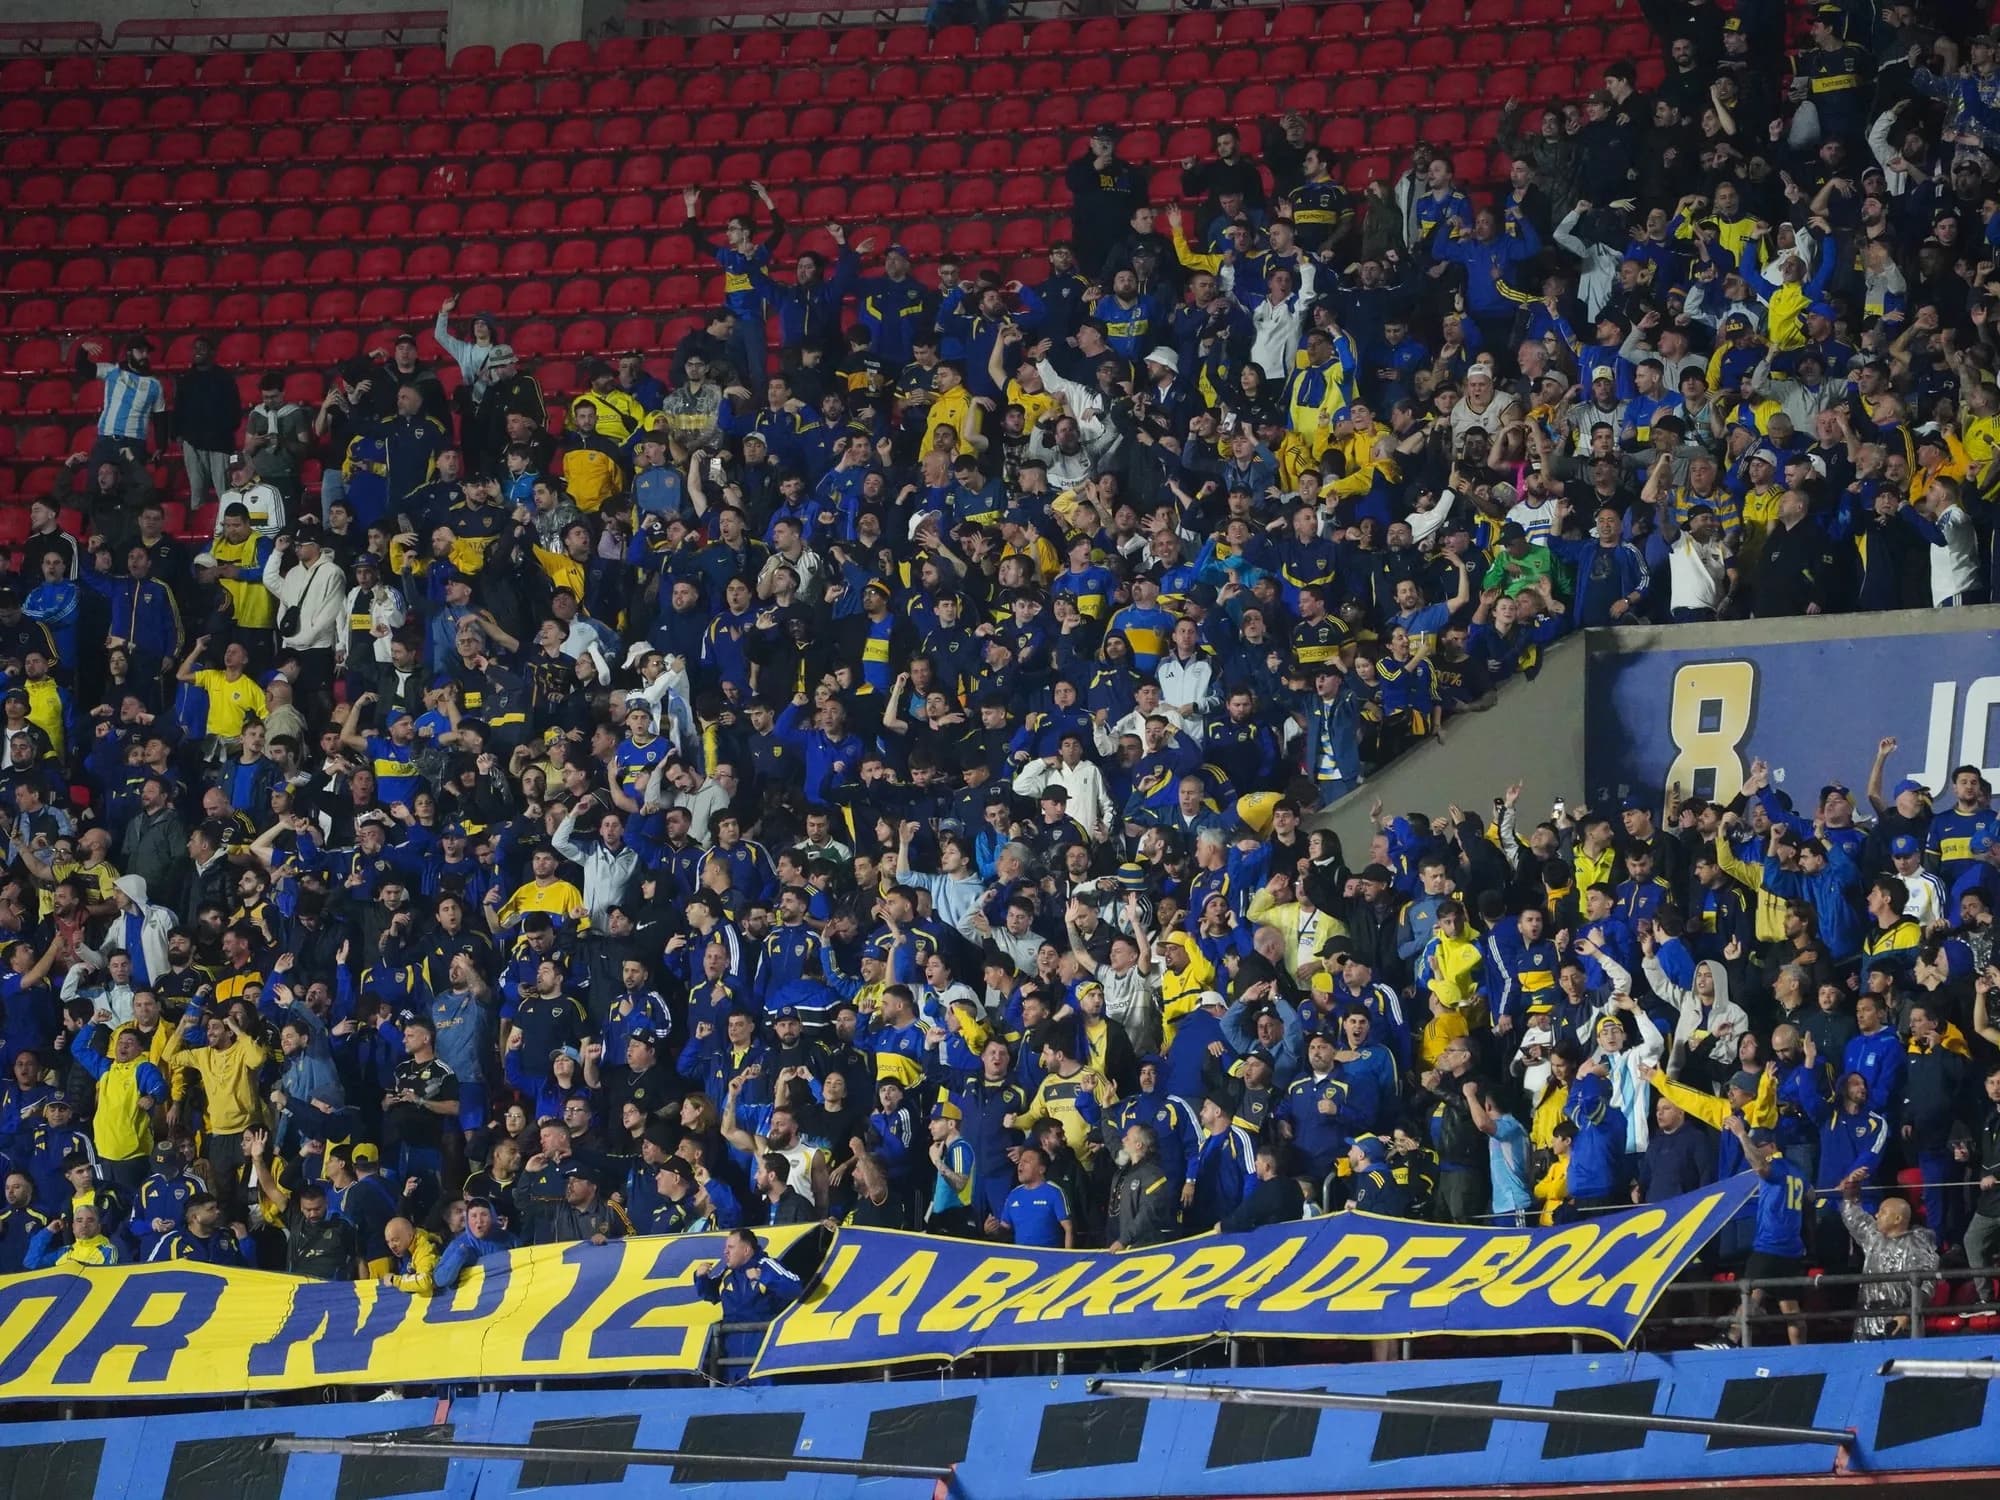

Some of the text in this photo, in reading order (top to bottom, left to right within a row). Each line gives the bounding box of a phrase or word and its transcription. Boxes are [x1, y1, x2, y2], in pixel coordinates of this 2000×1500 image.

[1663, 659, 1756, 830] 8
[1786, 1175, 1804, 1210] 12
[522, 1236, 769, 1362] 12
[776, 1193, 1726, 1347] LA BARRA DE BOCA
